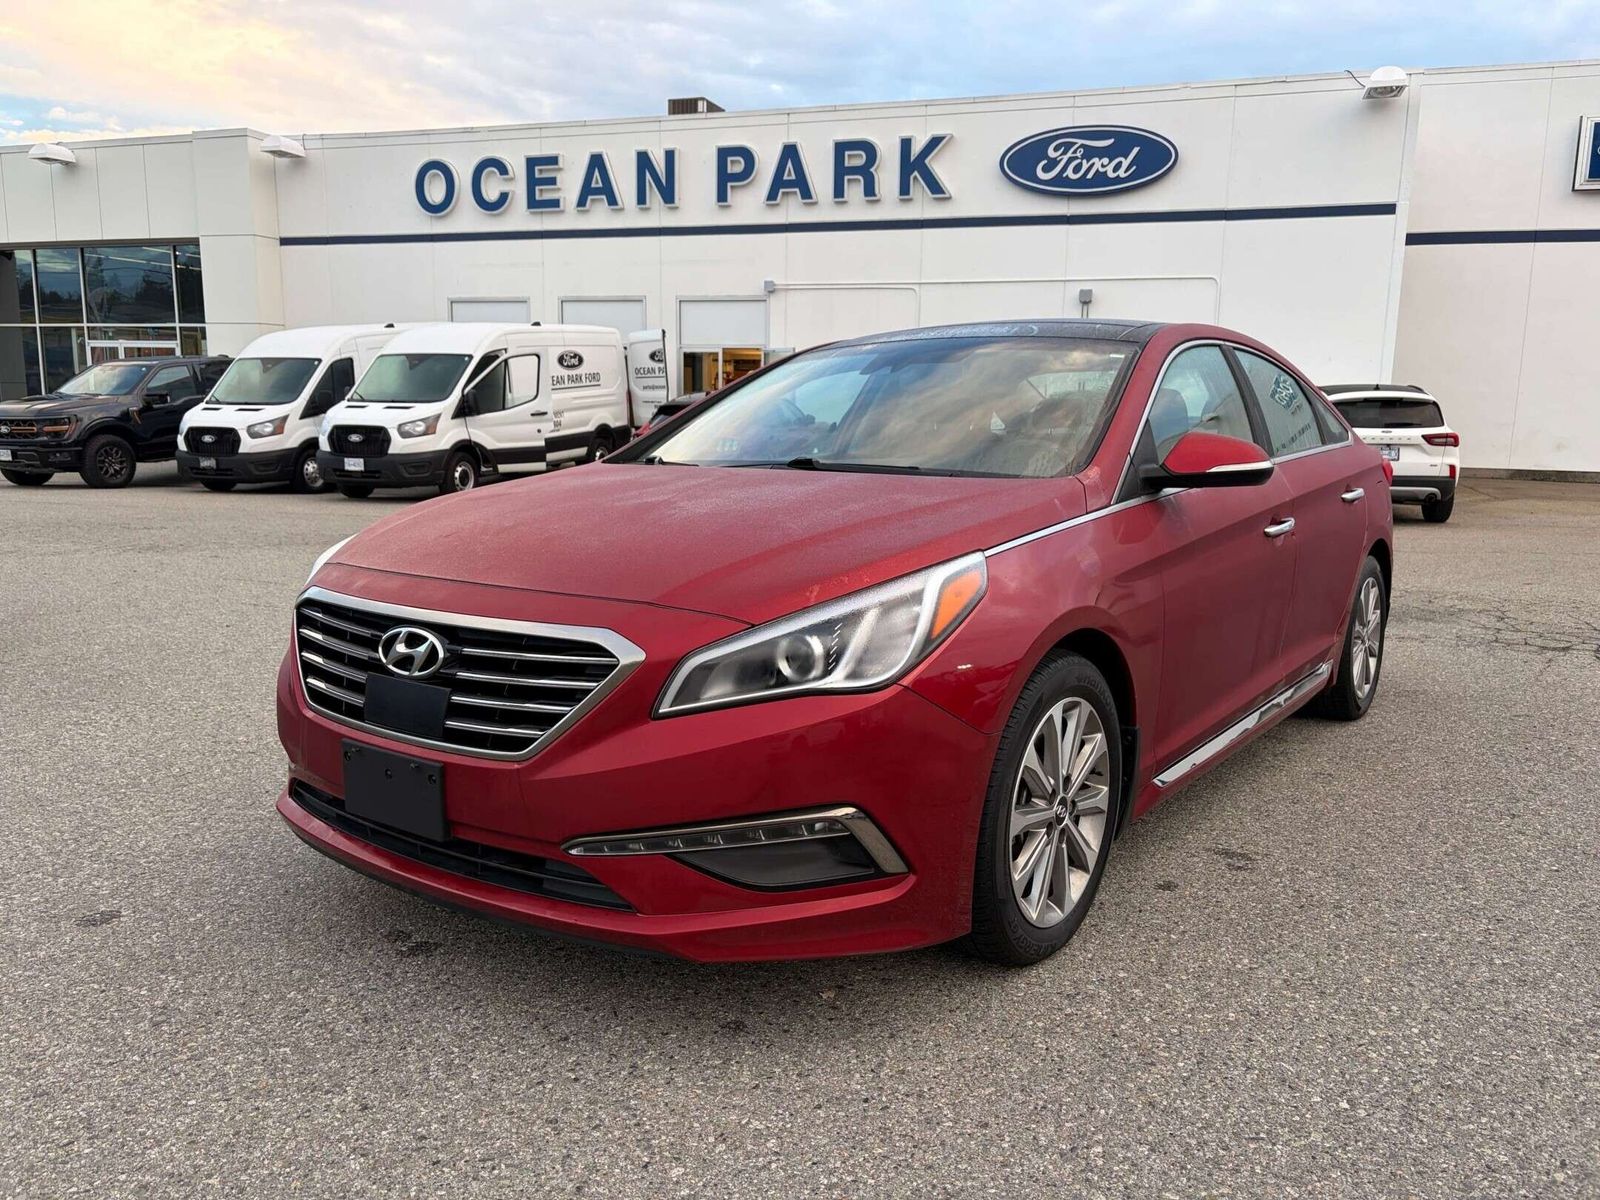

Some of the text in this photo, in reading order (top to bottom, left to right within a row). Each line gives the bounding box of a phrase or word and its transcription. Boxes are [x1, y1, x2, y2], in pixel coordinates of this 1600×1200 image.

[1036, 138, 1141, 180] Ford
[413, 133, 955, 217] OCEAN PARK
[551, 372, 601, 386] EAN PARK FORD
[635, 366, 656, 376] OCEAN
